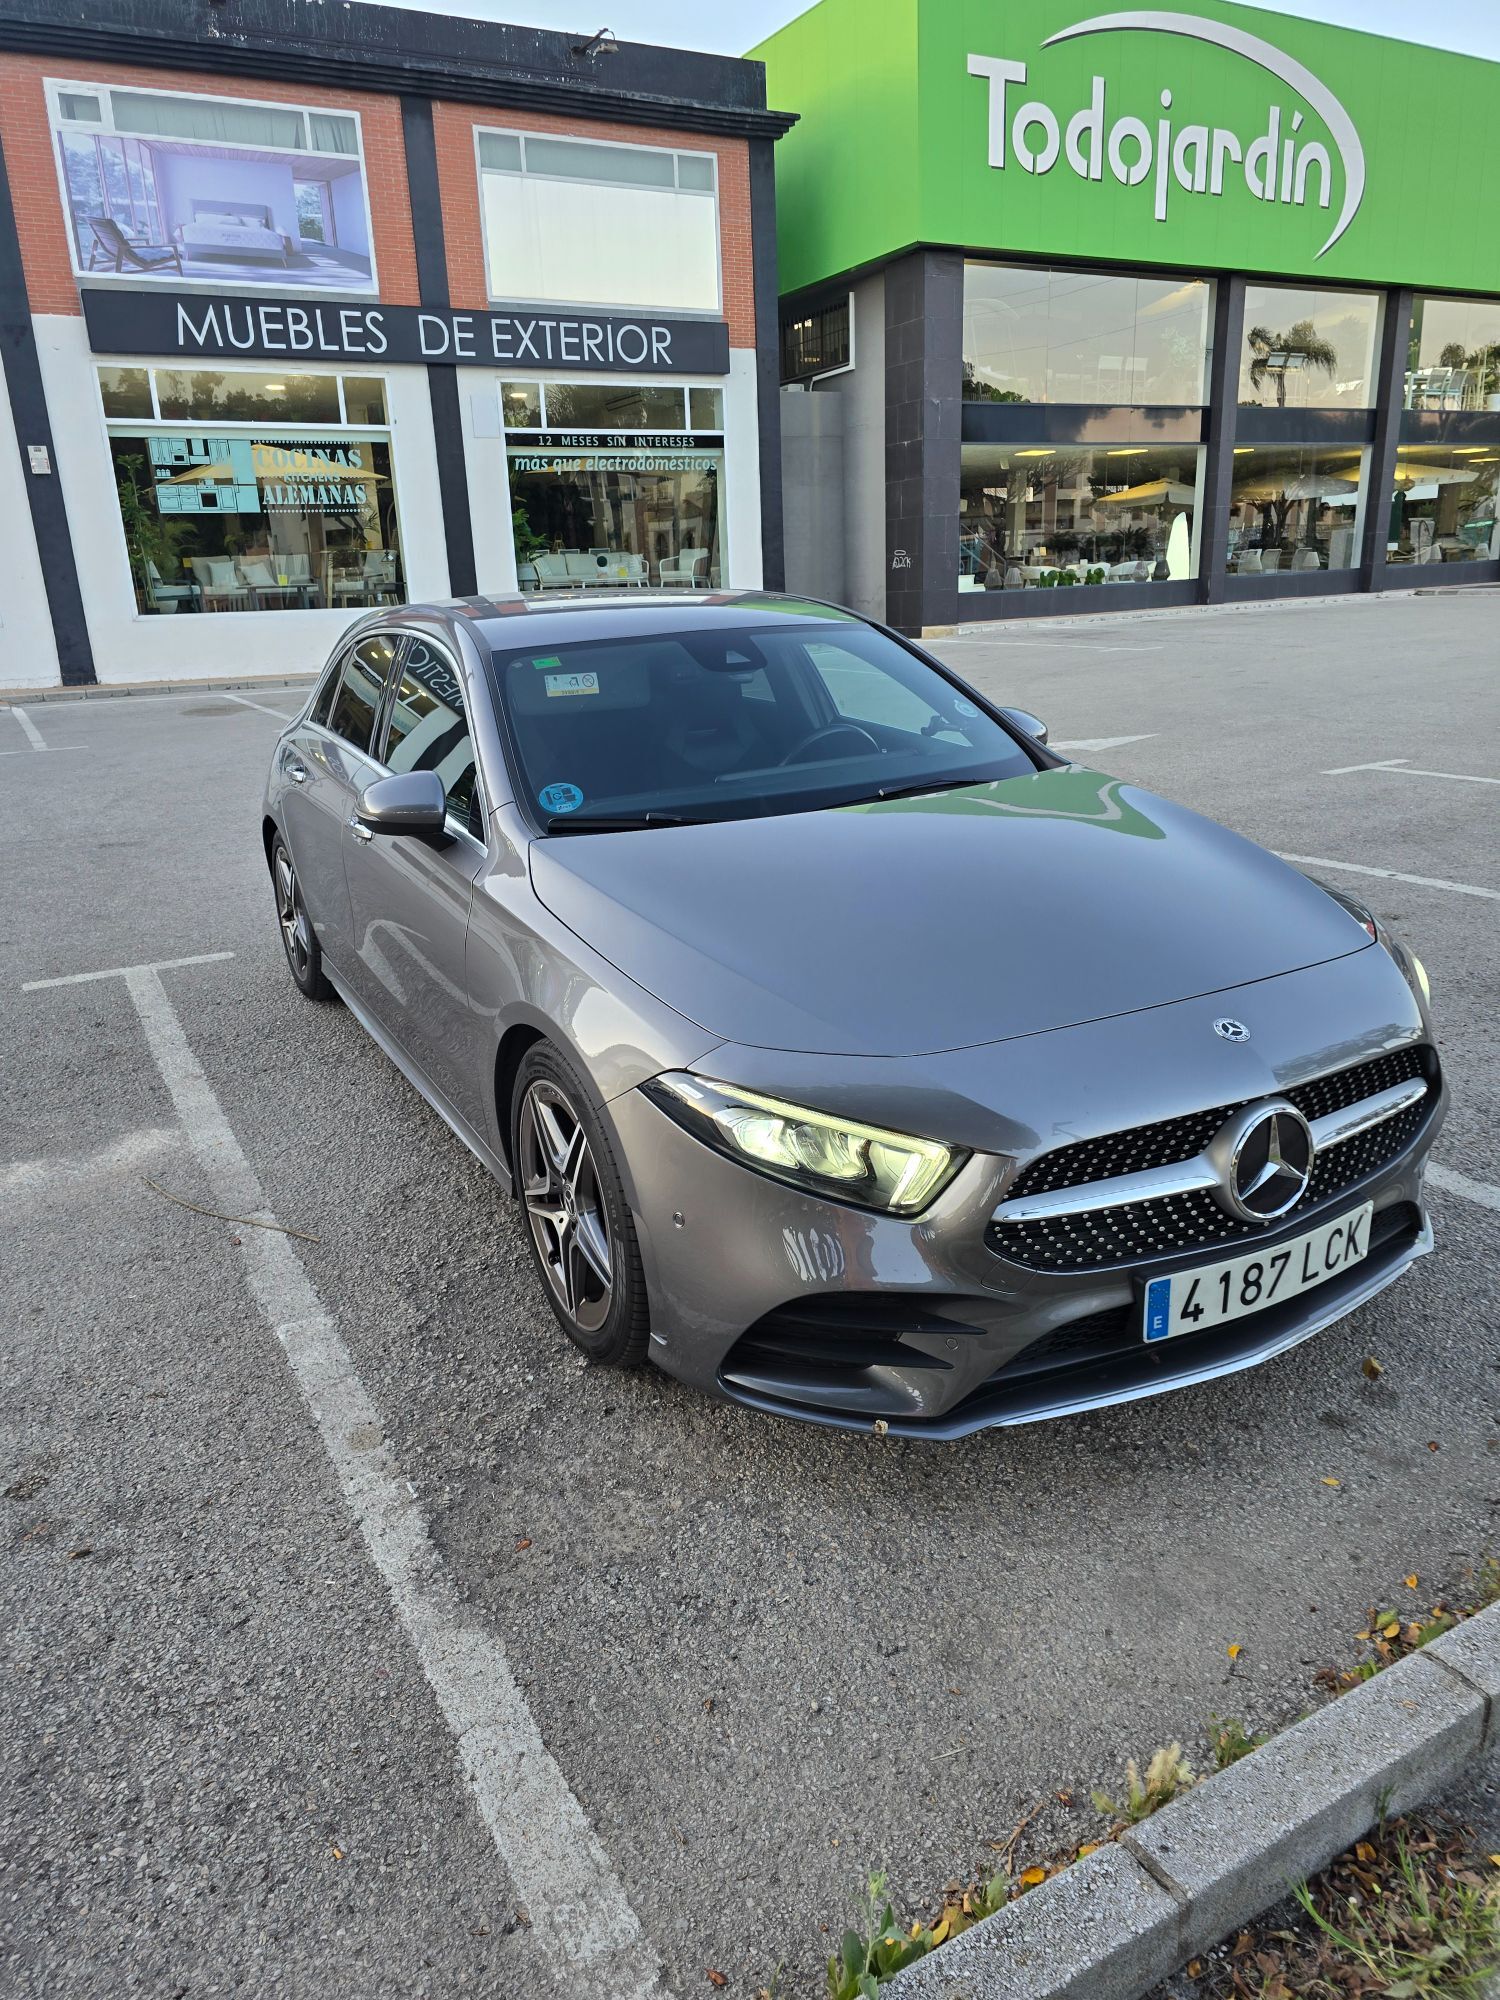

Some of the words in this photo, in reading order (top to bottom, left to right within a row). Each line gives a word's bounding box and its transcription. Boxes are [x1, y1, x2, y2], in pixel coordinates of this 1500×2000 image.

[967, 53, 1332, 222] Todojardín
[177, 303, 387, 355] MUEBLES
[417, 313, 477, 358] DE
[492, 317, 673, 364] EXTERIOR
[538, 435, 553, 446] 12
[561, 435, 599, 447] MESES
[607, 435, 627, 447] SIN
[634, 436, 695, 448] INTERESES
[256, 448, 363, 469] COCINAS
[514, 454, 548, 471] más
[553, 457, 581, 475] que
[586, 455, 718, 472] electrodomésticos
[262, 484, 368, 505] ALEMANAS
[1180, 1250, 1292, 1323] 4187
[1301, 1214, 1364, 1284] LCK
[1153, 1315, 1163, 1330] E
